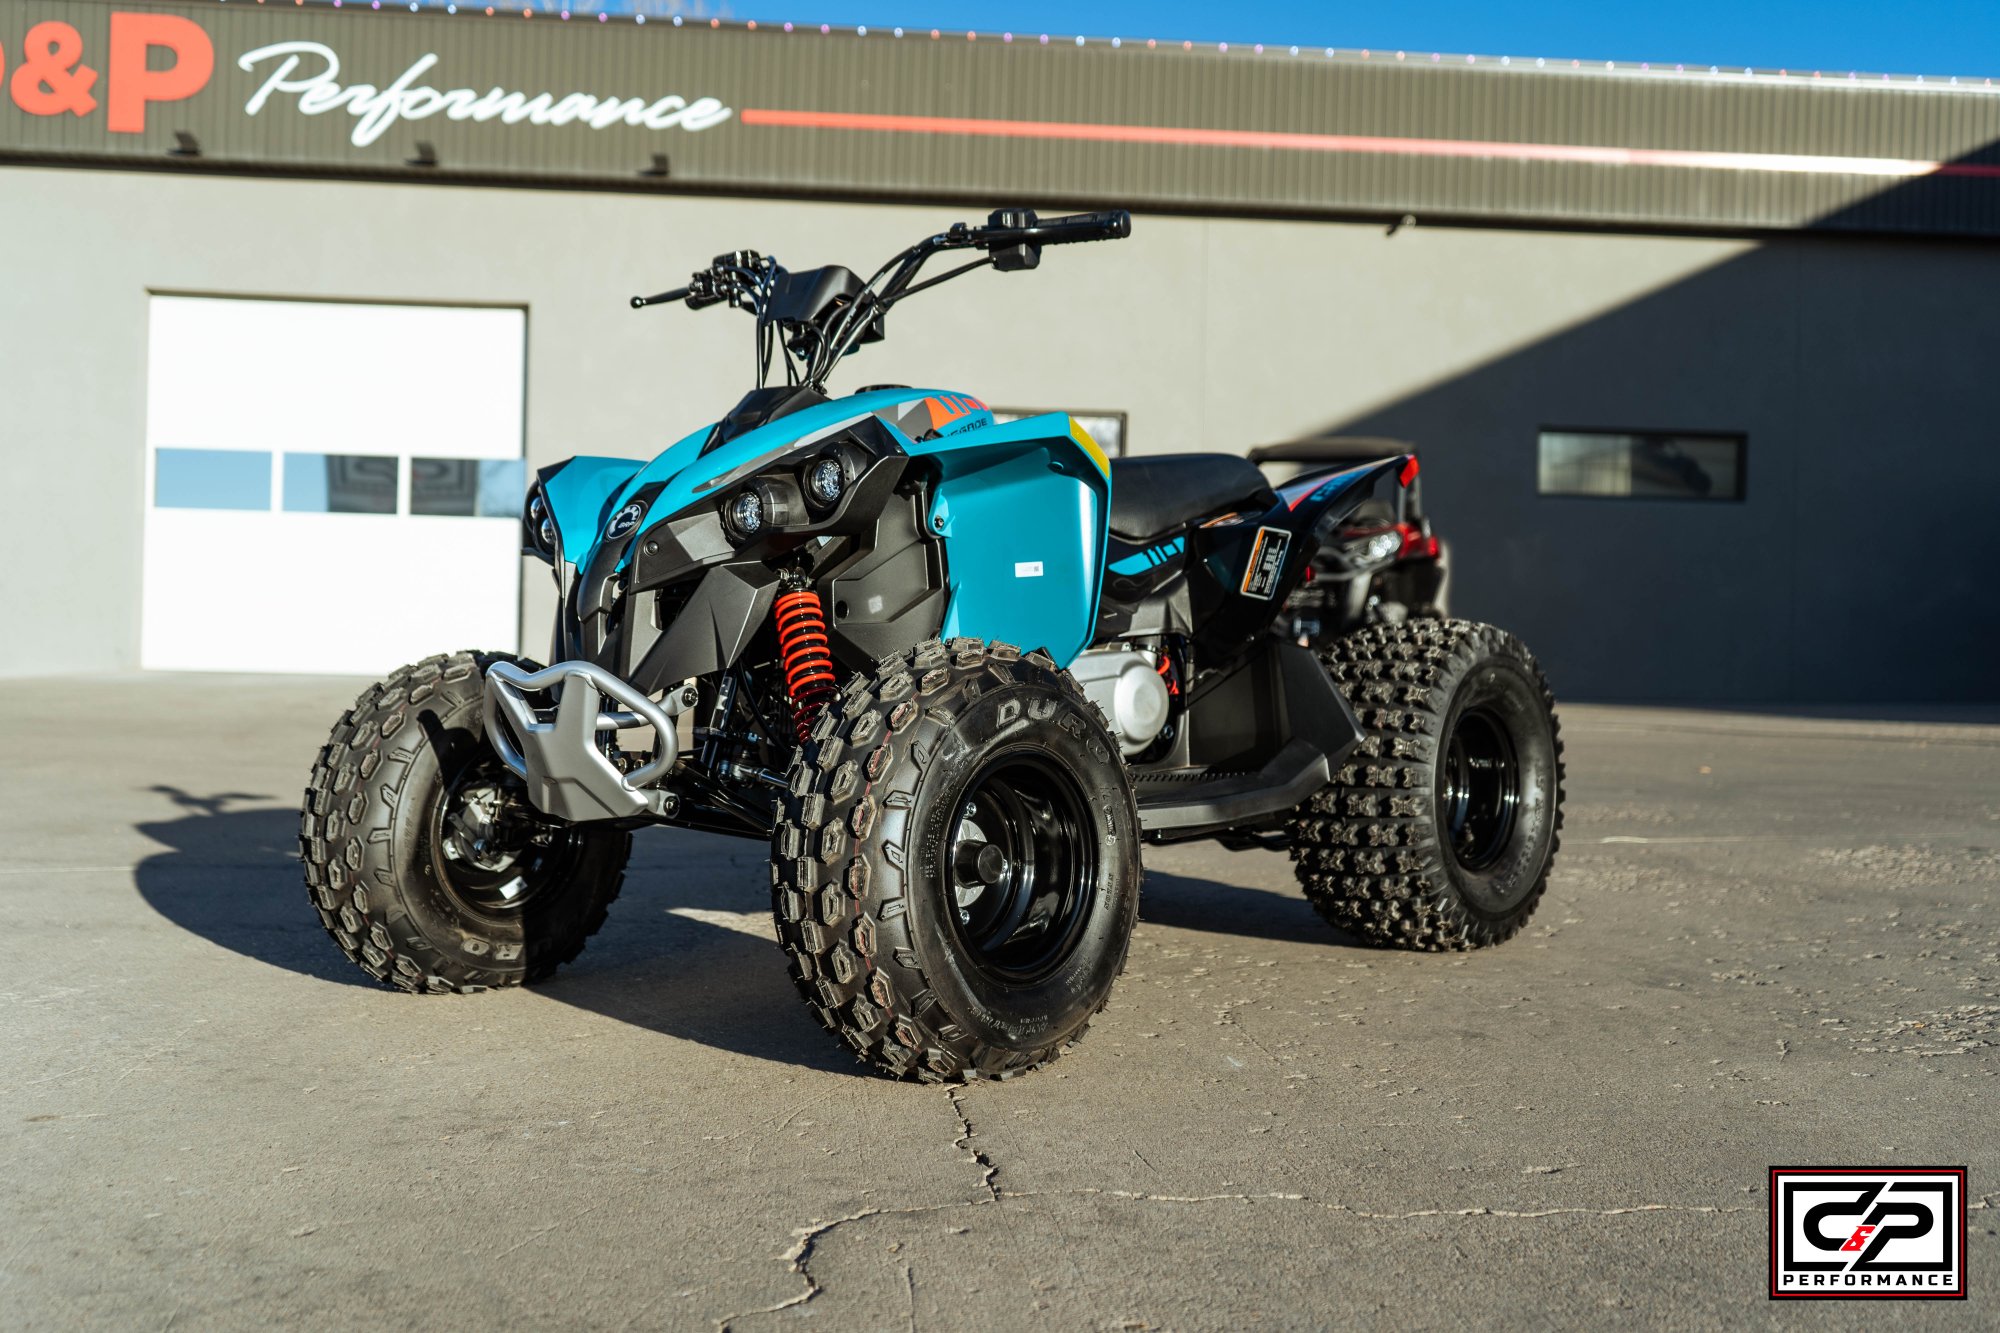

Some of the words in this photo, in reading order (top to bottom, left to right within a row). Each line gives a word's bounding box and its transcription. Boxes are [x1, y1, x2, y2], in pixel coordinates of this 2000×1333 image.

[0, 11, 214, 133] &P
[238, 41, 732, 148] Performance
[996, 698, 1110, 764] DURO
